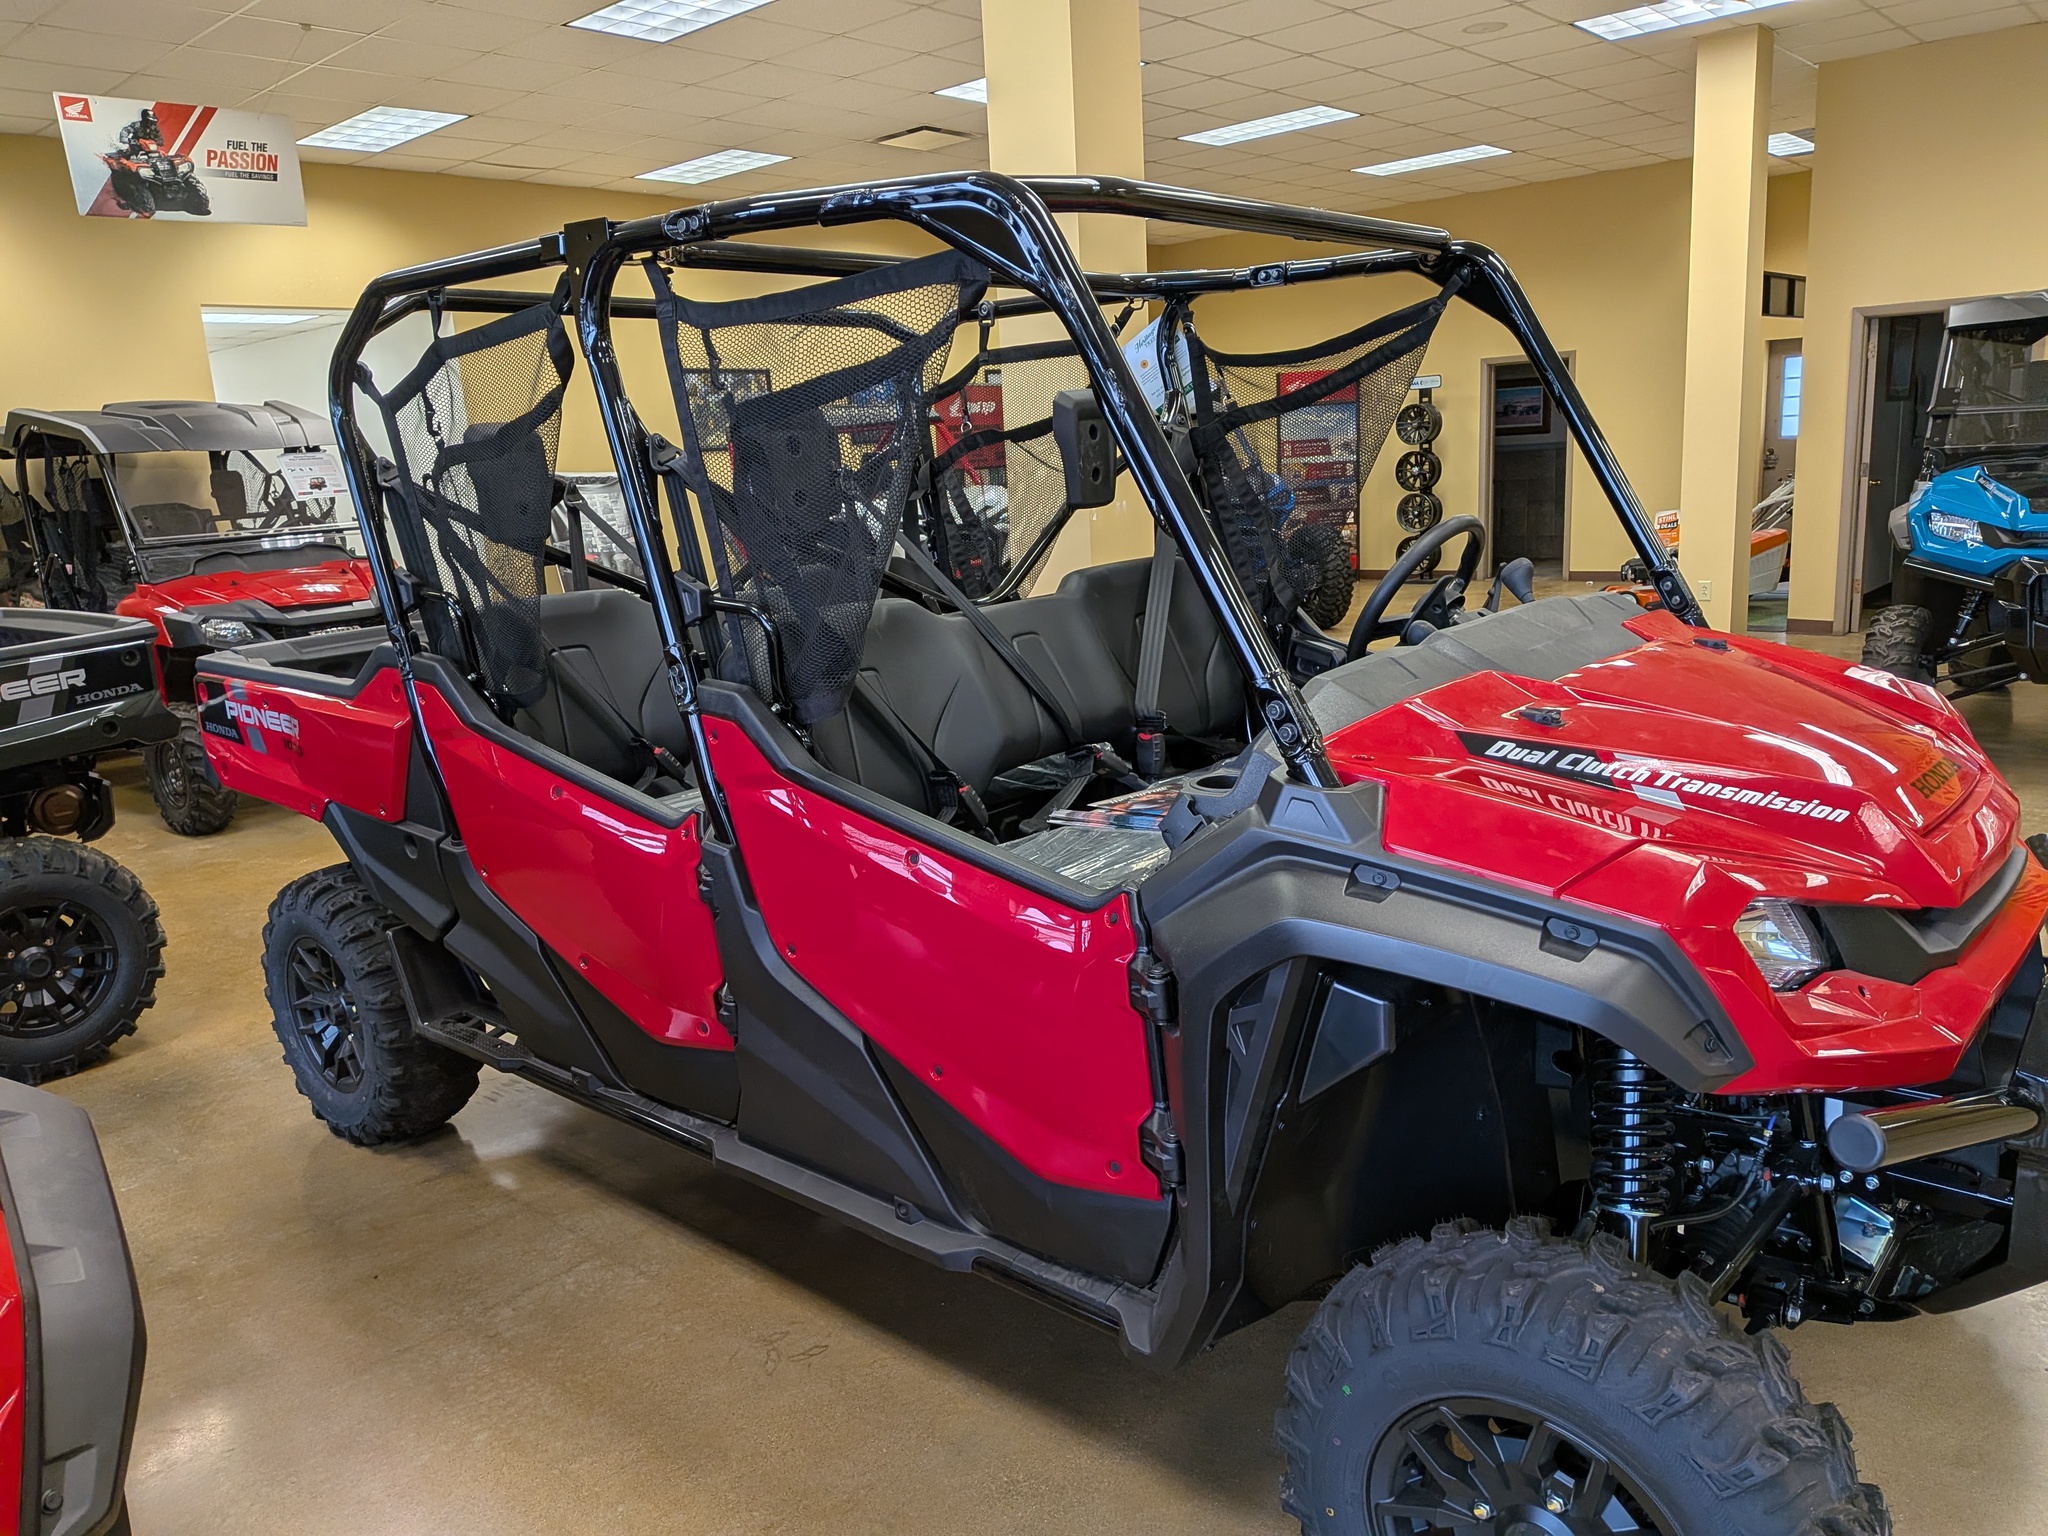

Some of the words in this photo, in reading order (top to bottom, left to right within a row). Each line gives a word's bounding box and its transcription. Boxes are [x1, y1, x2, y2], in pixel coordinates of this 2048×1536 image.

[226, 139, 249, 151] FUEL
[250, 141, 268, 153] THE
[206, 149, 278, 172] PASSION
[250, 173, 274, 181] SAVINGS
[1658, 514, 1676, 524] STIHL
[0, 668, 87, 702] EER
[74, 682, 145, 705] HONDA
[205, 721, 240, 739] HONDA
[224, 699, 300, 740] PIONEER
[1484, 740, 1550, 767] Dual
[1556, 752, 1653, 785] Clutch
[1658, 768, 1853, 824] Transmission
[1910, 757, 1963, 800] HONDA
